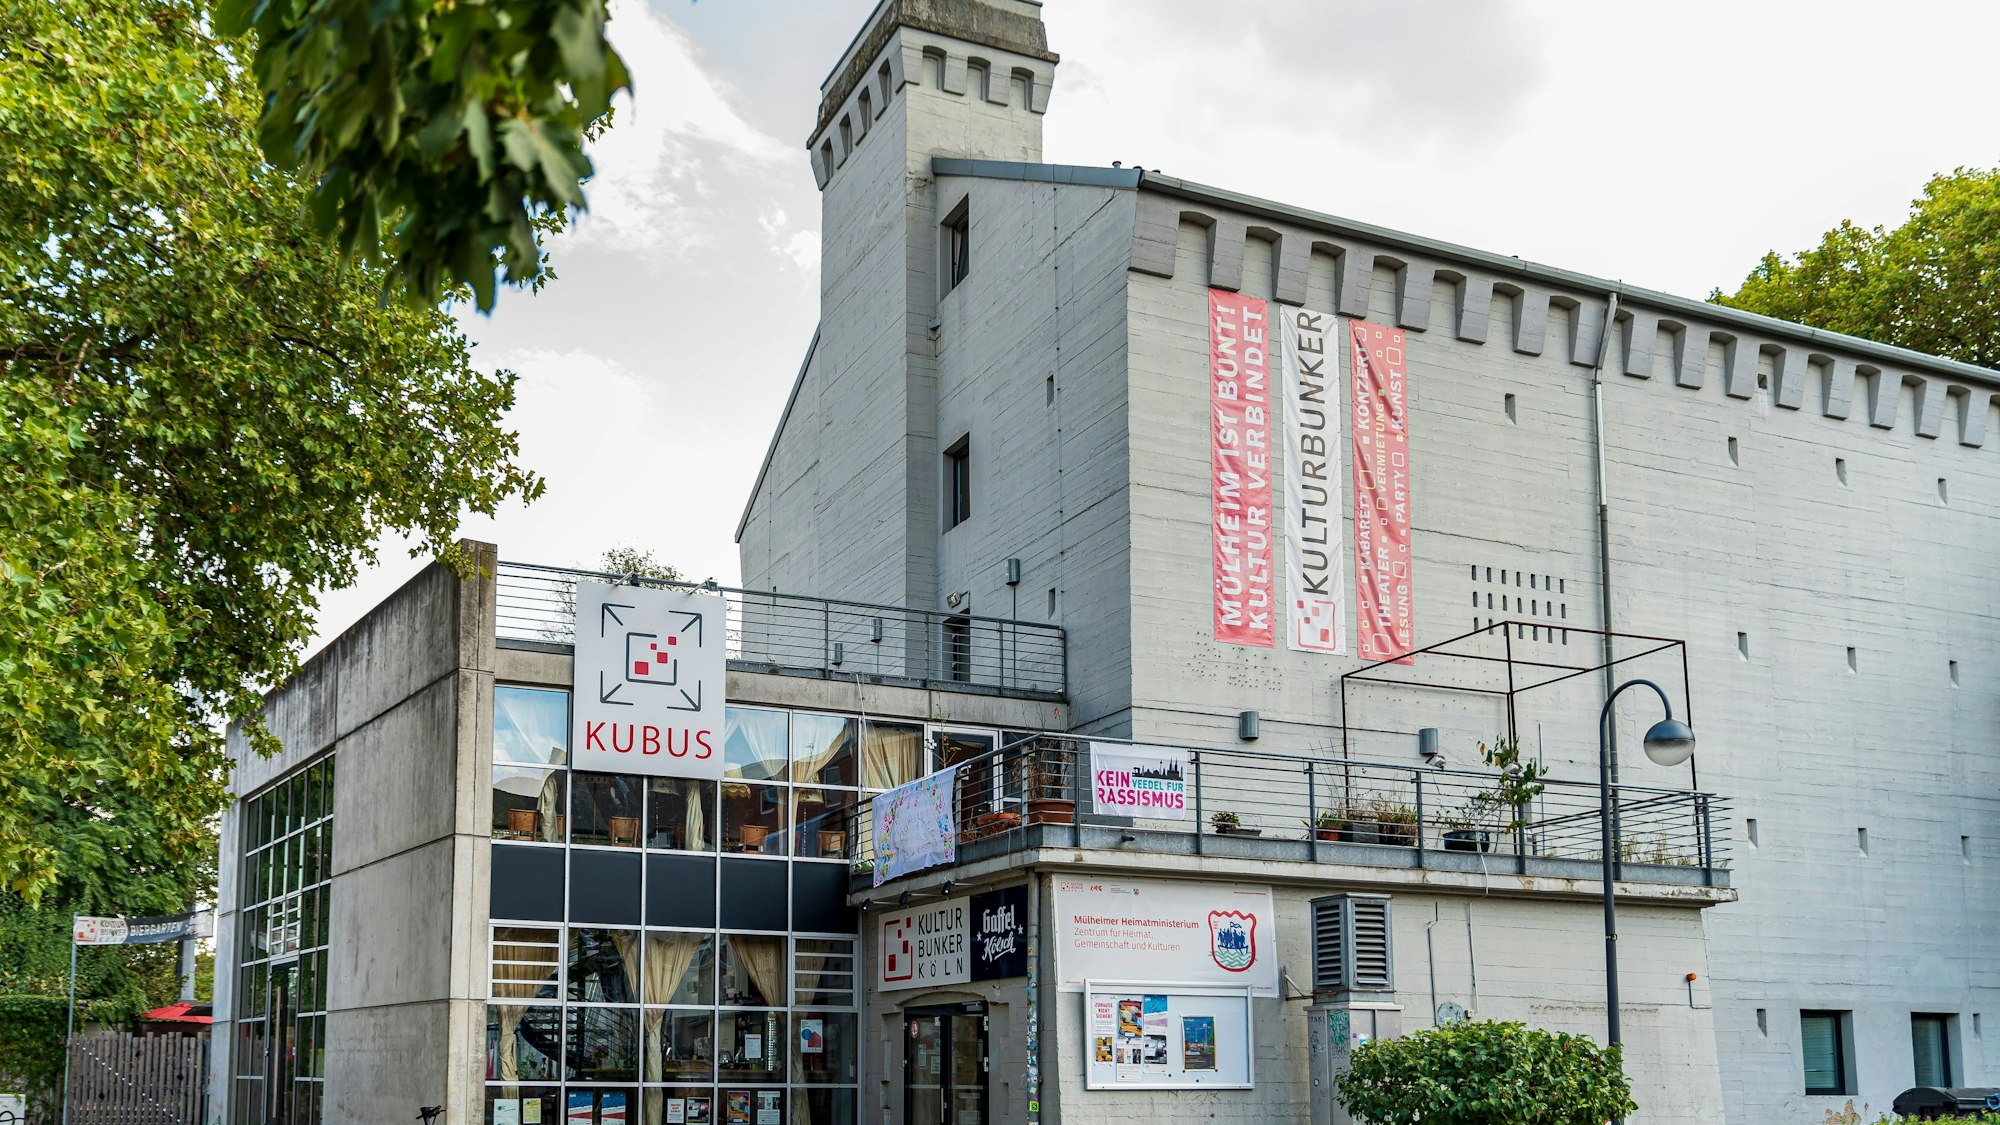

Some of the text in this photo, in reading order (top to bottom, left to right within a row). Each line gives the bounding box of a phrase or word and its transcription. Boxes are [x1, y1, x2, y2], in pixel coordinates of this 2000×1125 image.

[1216, 304, 1242, 627] MÜLHEIM IST BUNT!
[1243, 306, 1269, 630] KULTUR VERBINDET
[1296, 312, 1329, 596] KULTURBUNKER
[1356, 343, 1371, 570] KABARETT KONZERT
[1375, 403, 1392, 628] THEATER VERMIETUNG
[1390, 368, 1410, 647] LESUNG PARTY KUNST
[586, 721, 712, 759] KUBUS
[1097, 770, 1130, 788] KEIN
[1132, 779, 1163, 790] VEEDEL
[1097, 787, 1184, 809] RASSISMUS
[129, 921, 183, 937] BIERGARTEN
[918, 907, 963, 936] KULTUR
[982, 904, 1017, 934] Gaffel
[1073, 915, 1119, 926] Mülheimer
[1121, 917, 1200, 929] Heimatministerium
[1074, 927, 1154, 940] Zentrum für Heimat,
[918, 933, 963, 958] BUNKER
[981, 931, 1017, 963] Kölsch
[1074, 939, 1181, 952] Gemeinschaft und Kulturen
[918, 957, 963, 979] KÖLN
